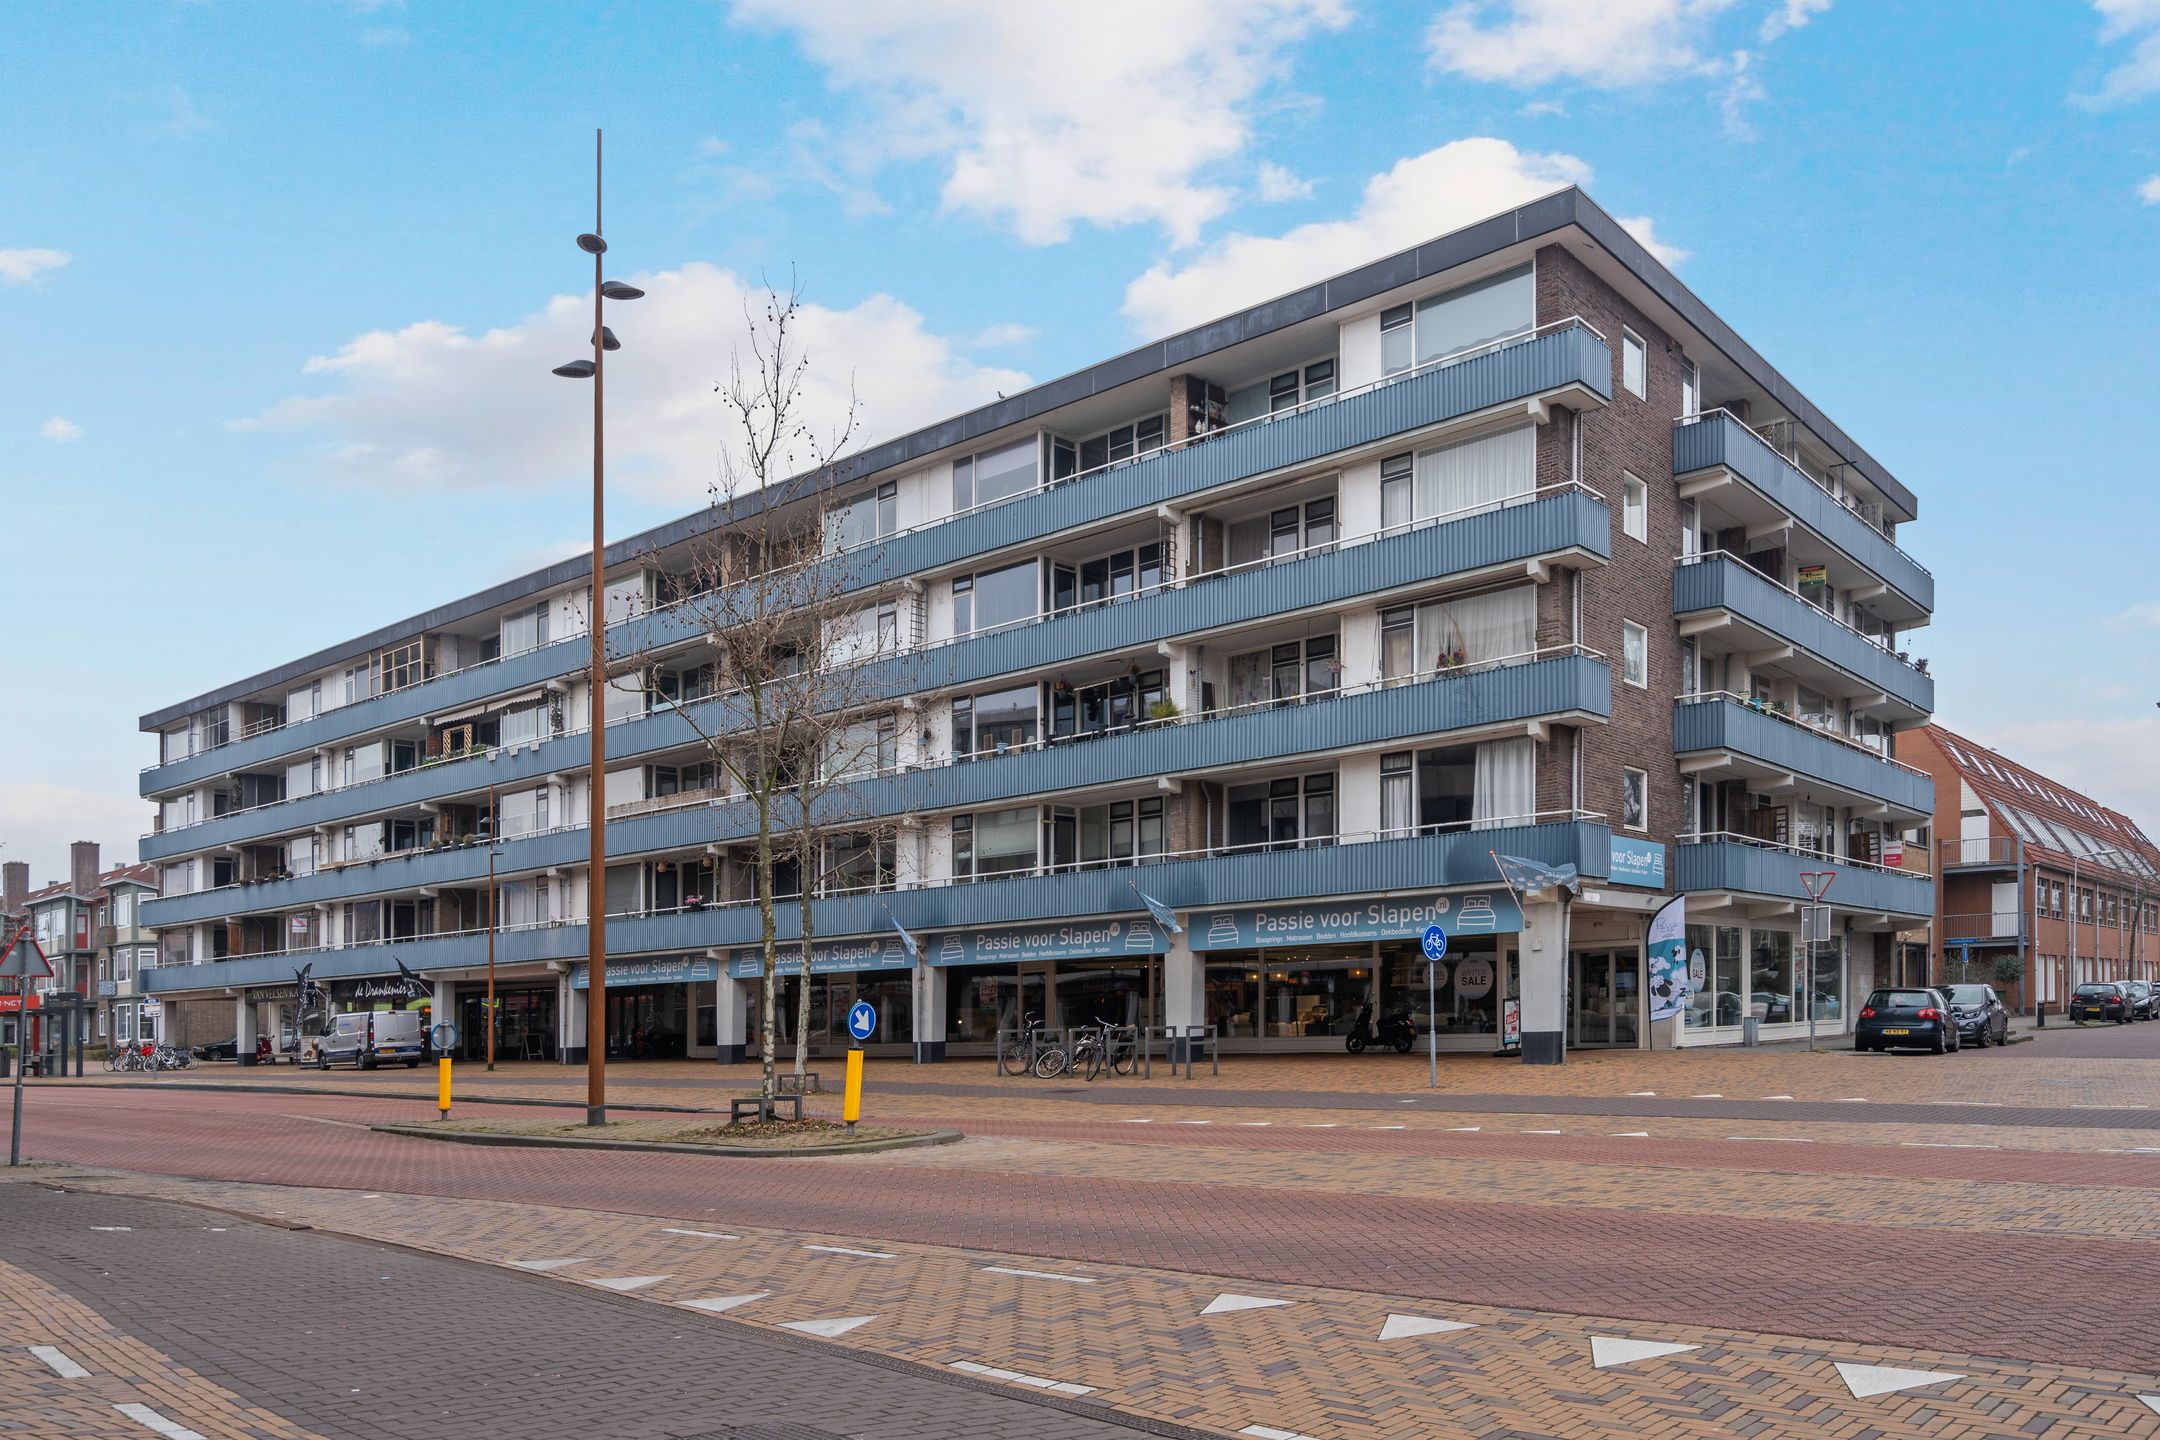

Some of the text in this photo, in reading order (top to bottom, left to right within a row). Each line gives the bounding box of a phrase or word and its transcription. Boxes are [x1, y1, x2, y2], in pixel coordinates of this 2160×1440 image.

[1627, 850, 1648, 869] Slapen
[1255, 911, 1314, 932] Passie
[1320, 911, 1362, 928] voor
[1367, 904, 1437, 928] Slapen
[976, 932, 1020, 950] Passie
[1024, 933, 1056, 947] voor
[1059, 928, 1111, 948] Slapen
[1255, 936, 1283, 944] Boxsprings
[1286, 934, 1314, 942] Matrassen
[1316, 932, 1337, 940] Bedden
[1339, 930, 1378, 938] Hoofdkussens
[1380, 927, 1413, 936] Dekbedden
[775, 948, 802, 964] assie
[811, 949, 829, 962] oor
[831, 945, 872, 963] Slapen
[604, 962, 628, 977] assie
[631, 963, 650, 975] voor
[652, 960, 684, 976] Slapen
[1692, 968, 1703, 979] SALE
[1461, 976, 1487, 986] SALE
